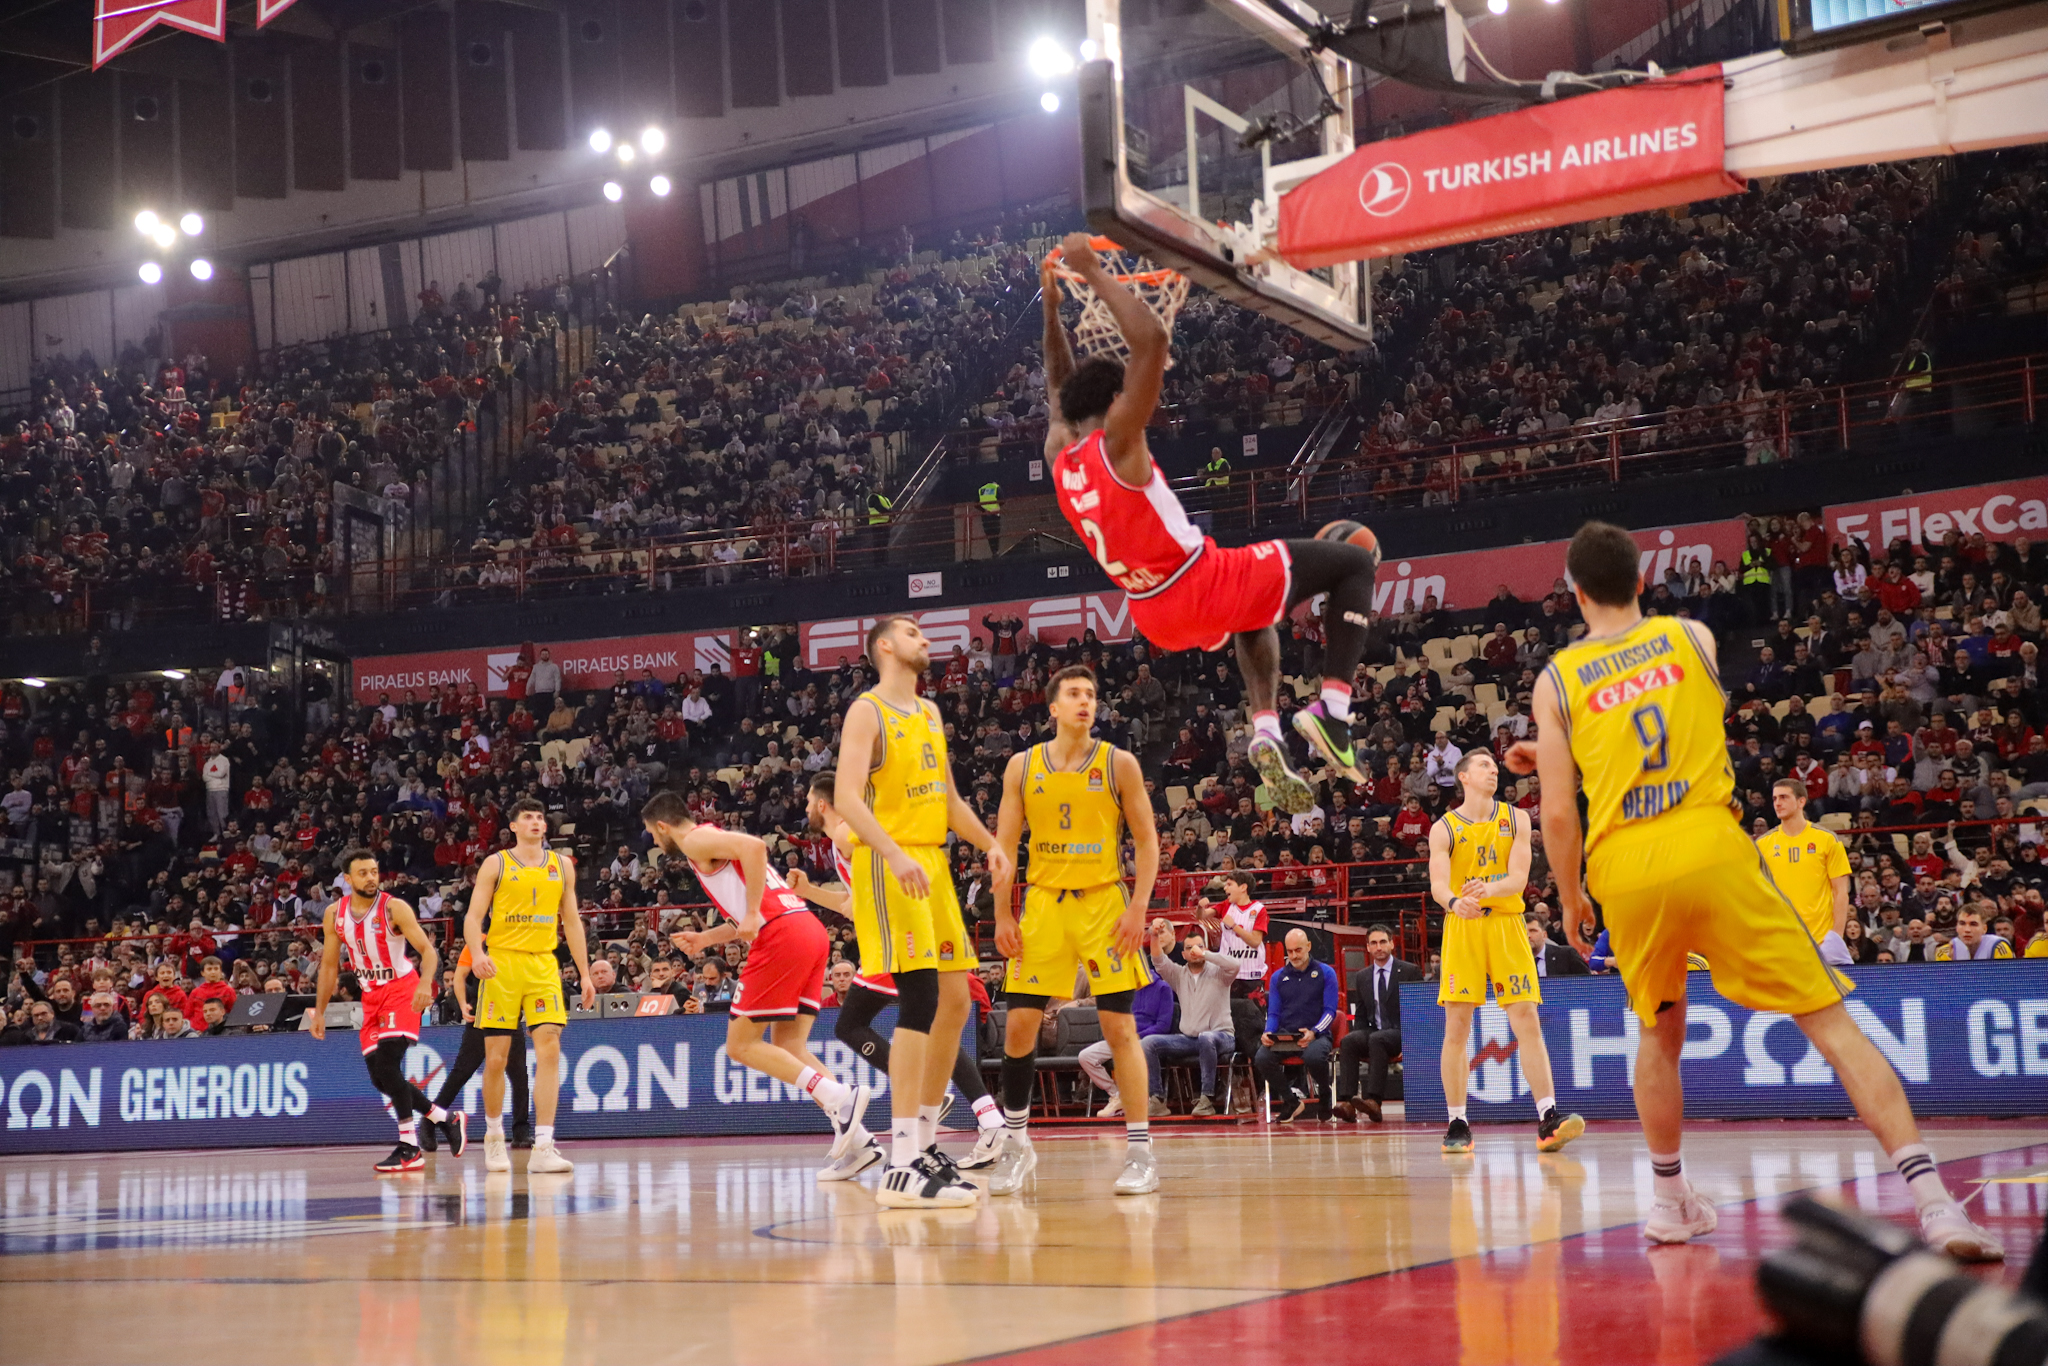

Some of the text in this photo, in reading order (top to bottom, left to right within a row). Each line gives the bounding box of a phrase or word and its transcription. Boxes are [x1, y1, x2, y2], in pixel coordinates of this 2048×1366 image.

[1423, 122, 1698, 193] TURKISH AIRLINES
[1080, 518, 1128, 576] 2
[563, 651, 678, 675] PIRAEUS BANK
[1576, 633, 1675, 687] MATTISSECK
[360, 668, 471, 691] PIRAEUS BANK
[1596, 664, 1679, 711] GAZI
[1631, 704, 1670, 772] 9
[1622, 779, 1690, 820] BERLIN
[1059, 803, 1071, 830] 3
[1035, 840, 1102, 854] interzero
[1477, 844, 1498, 867] 34
[1788, 846, 1800, 863] 10
[532, 887, 537, 906] 1
[504, 911, 555, 924] interzero
[357, 939, 366, 956] 1
[1107, 947, 1122, 973] 3
[1509, 974, 1531, 995] 34
[553, 994, 558, 1012] 1
[641, 999, 659, 1014] 5
[388, 1012, 395, 1029] 1
[0, 1066, 102, 1131] ΩΝ
[119, 1061, 309, 1122] GENEROUS
